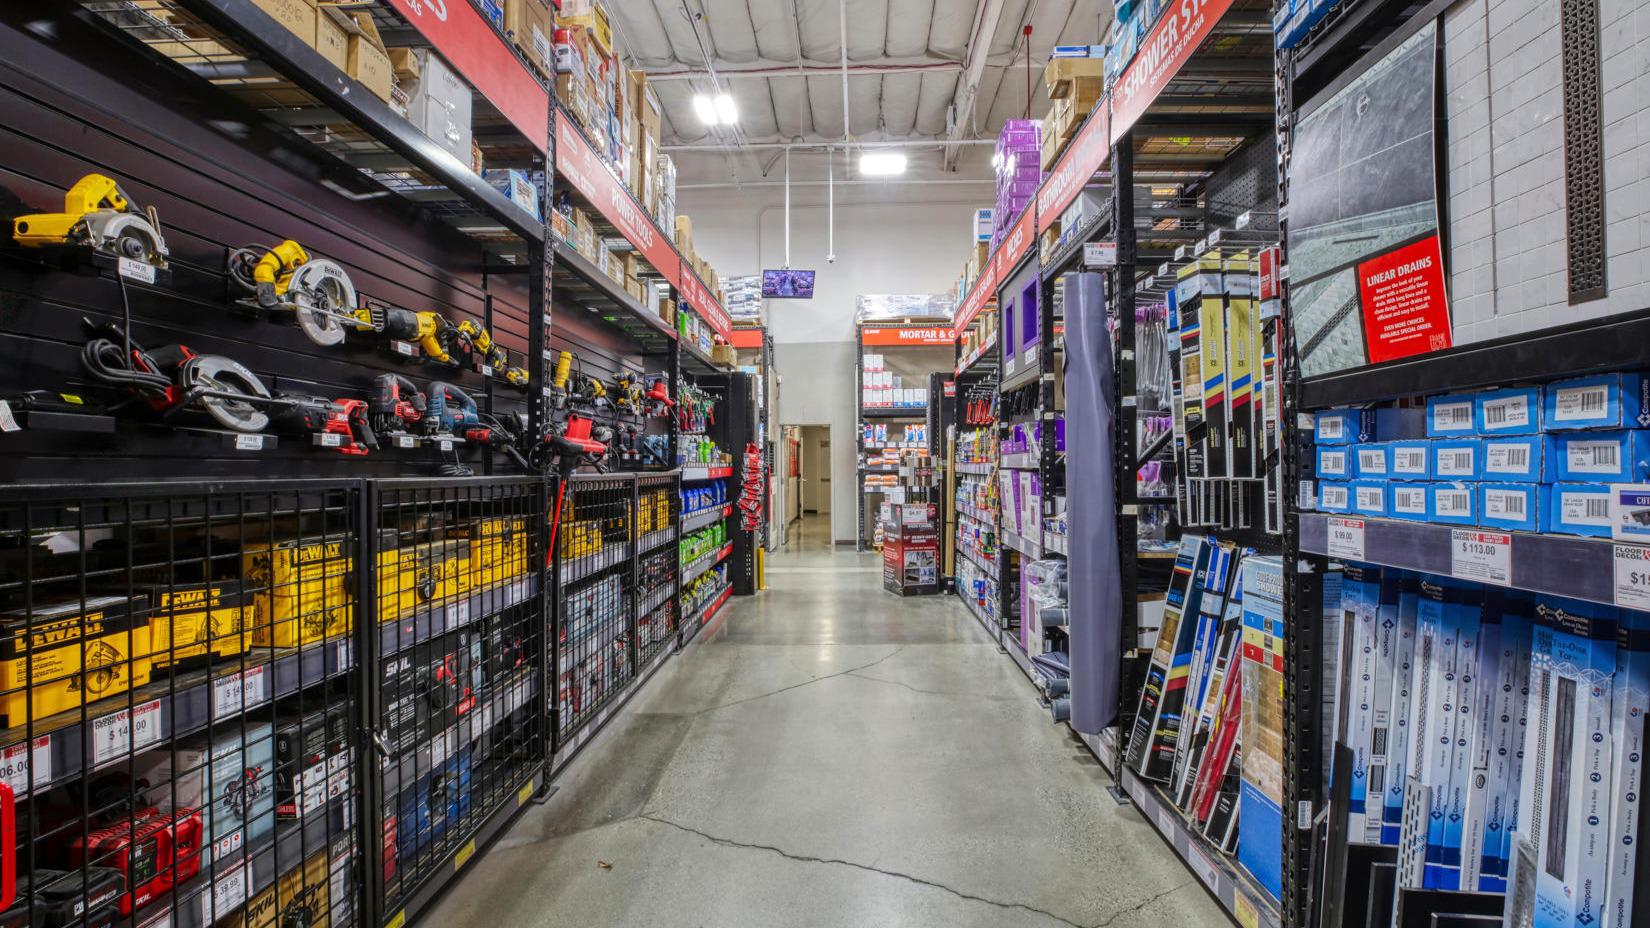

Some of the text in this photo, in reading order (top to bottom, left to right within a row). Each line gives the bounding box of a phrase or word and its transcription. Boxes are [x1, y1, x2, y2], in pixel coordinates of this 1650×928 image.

[1124, 14, 1179, 104] SHOWER
[1150, 13, 1205, 89] SISTEMAS DE DUCHA
[611, 186, 636, 229] POWER
[636, 214, 653, 248] TOOLS
[1366, 256, 1432, 287] LINEAR DRAINS
[1394, 320, 1406, 328] MORE
[1406, 317, 1424, 326] CHOICES
[1400, 326, 1416, 334] SPECIAL
[899, 330, 946, 339] MORTAR &
[1334, 530, 1352, 540] $ 99.00
[1462, 542, 1496, 556] $ 113.00
[1616, 546, 1642, 554] FLOOR
[1616, 552, 1642, 560] DECOR
[110, 719, 146, 740] $ 14.00
[1435, 785, 1443, 810] Compotite
[1452, 787, 1460, 813] Compotite
[1581, 879, 1592, 912] Compotite
[248, 893, 274, 922] SKIL
